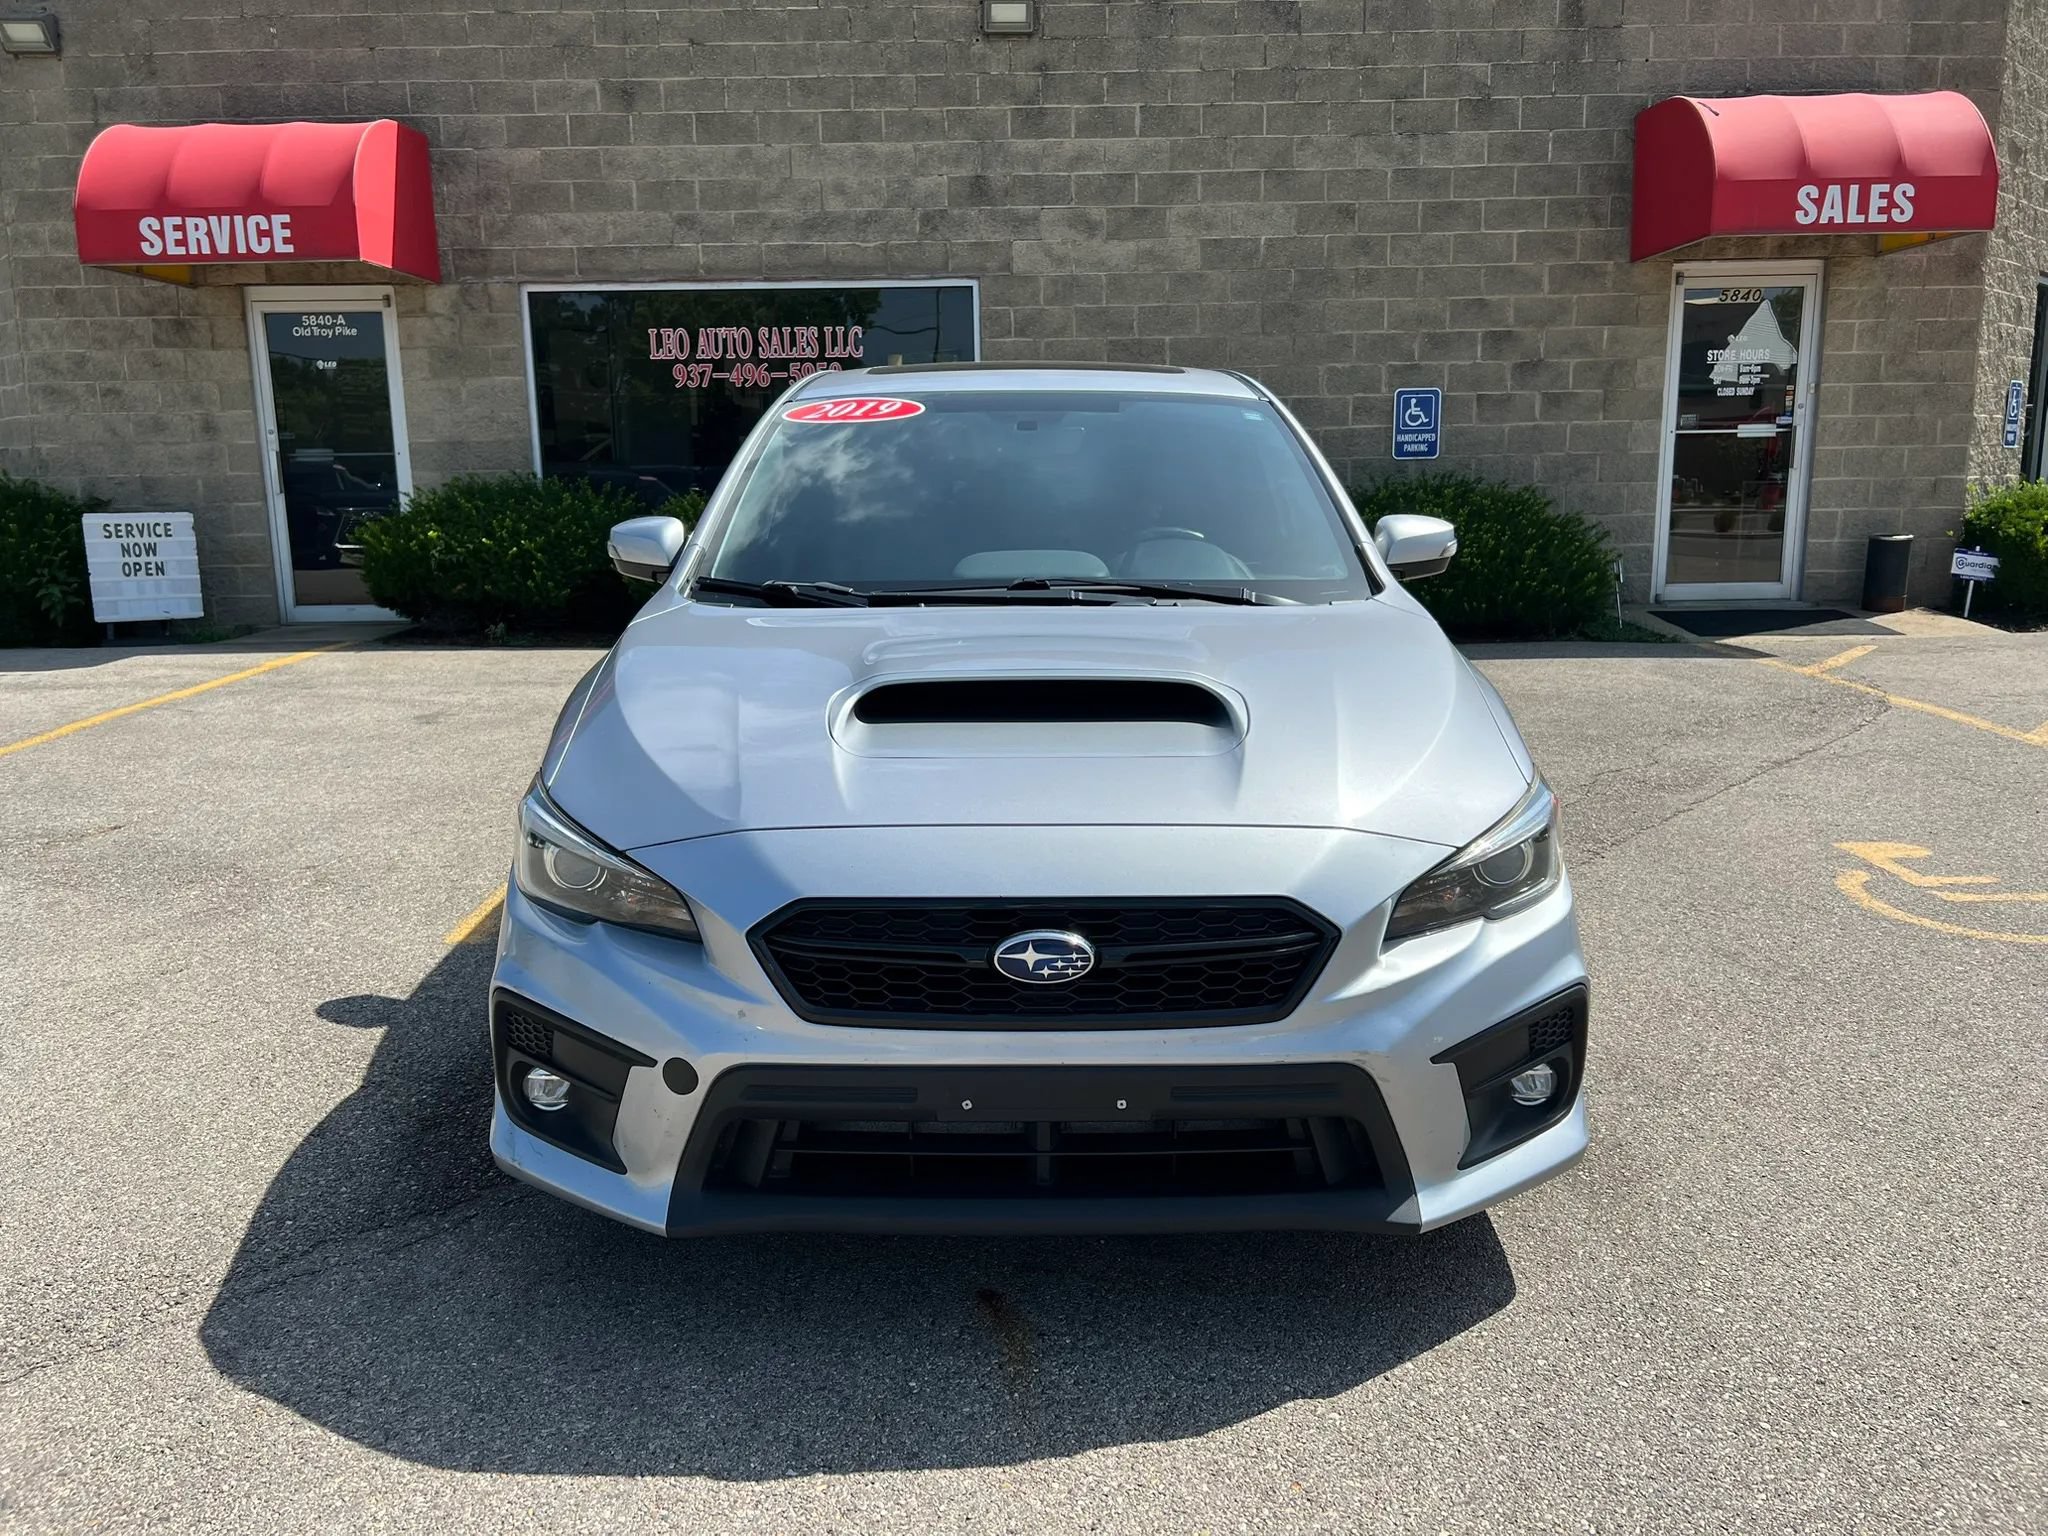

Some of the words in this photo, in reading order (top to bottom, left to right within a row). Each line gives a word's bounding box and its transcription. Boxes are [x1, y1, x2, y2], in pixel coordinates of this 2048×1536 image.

[1795, 183, 1916, 225] SALES
[138, 214, 295, 256] SERVICE
[1719, 289, 1761, 302] 5840
[302, 315, 346, 325] 5840-A
[293, 327, 311, 336] Old
[312, 327, 333, 338] Troy
[335, 327, 357, 336] Pike
[648, 327, 690, 360] LEO
[696, 326, 753, 360] AUTO
[758, 326, 819, 359] SALES
[823, 326, 864, 359] LLC
[1707, 349, 1737, 361] STORE
[1740, 348, 1770, 360] HOURS
[1717, 387, 1735, 396] CLOSED
[1736, 386, 1755, 396] SUNDAY
[802, 401, 903, 420] 2019
[1397, 434, 1435, 442] HANDICAPPED
[1404, 444, 1428, 452] PARKING
[102, 522, 173, 539] SERVICE
[120, 542, 158, 558] NOW
[121, 561, 166, 577] OPEN
[1956, 556, 1993, 570] Guardia
